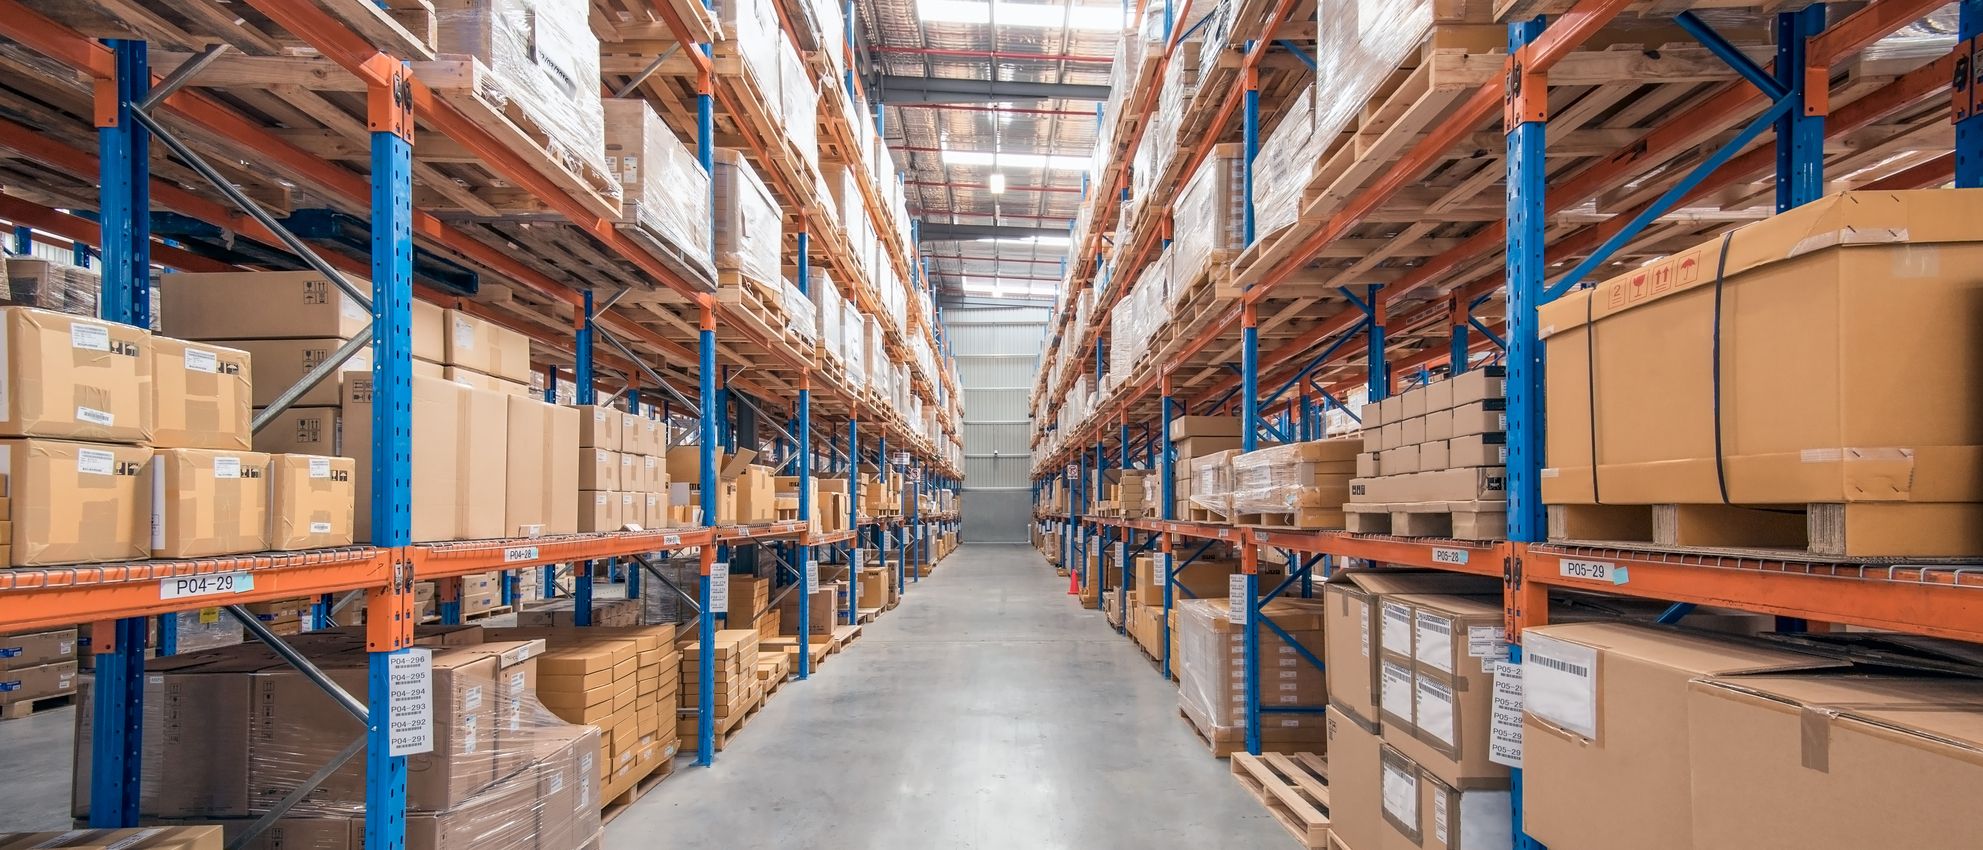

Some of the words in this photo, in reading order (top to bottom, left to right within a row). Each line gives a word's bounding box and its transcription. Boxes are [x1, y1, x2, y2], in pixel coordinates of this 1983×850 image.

[510, 549, 531, 559] P04-28
[1437, 550, 1458, 562] P05-28
[1568, 562, 1605, 578] P05-29
[177, 575, 233, 595] P04-29
[390, 656, 426, 665] P04-296
[1496, 664, 1522, 675] P05-2
[390, 672, 426, 681] P04-295
[390, 688, 426, 697] P04-294
[390, 703, 426, 713] P04-293
[390, 719, 426, 728] P04-292
[390, 735, 426, 744] P04-291
